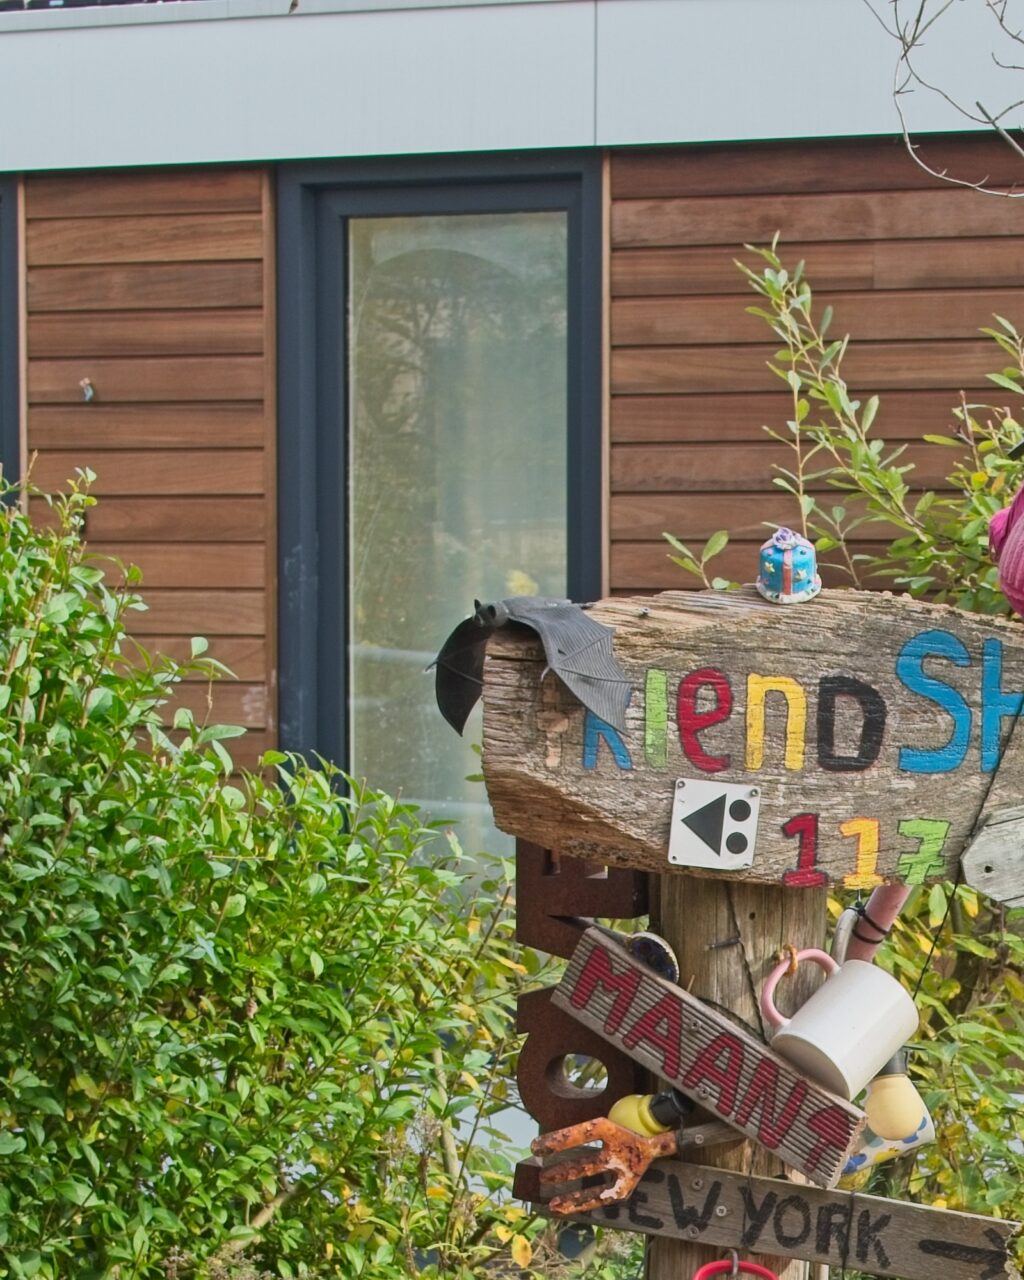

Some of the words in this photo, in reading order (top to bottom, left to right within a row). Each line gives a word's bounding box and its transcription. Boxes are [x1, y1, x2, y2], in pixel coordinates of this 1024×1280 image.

[782, 812, 952, 889] 117
[571, 946, 808, 1150] MAAN
[738, 1184, 892, 1269] YORK
